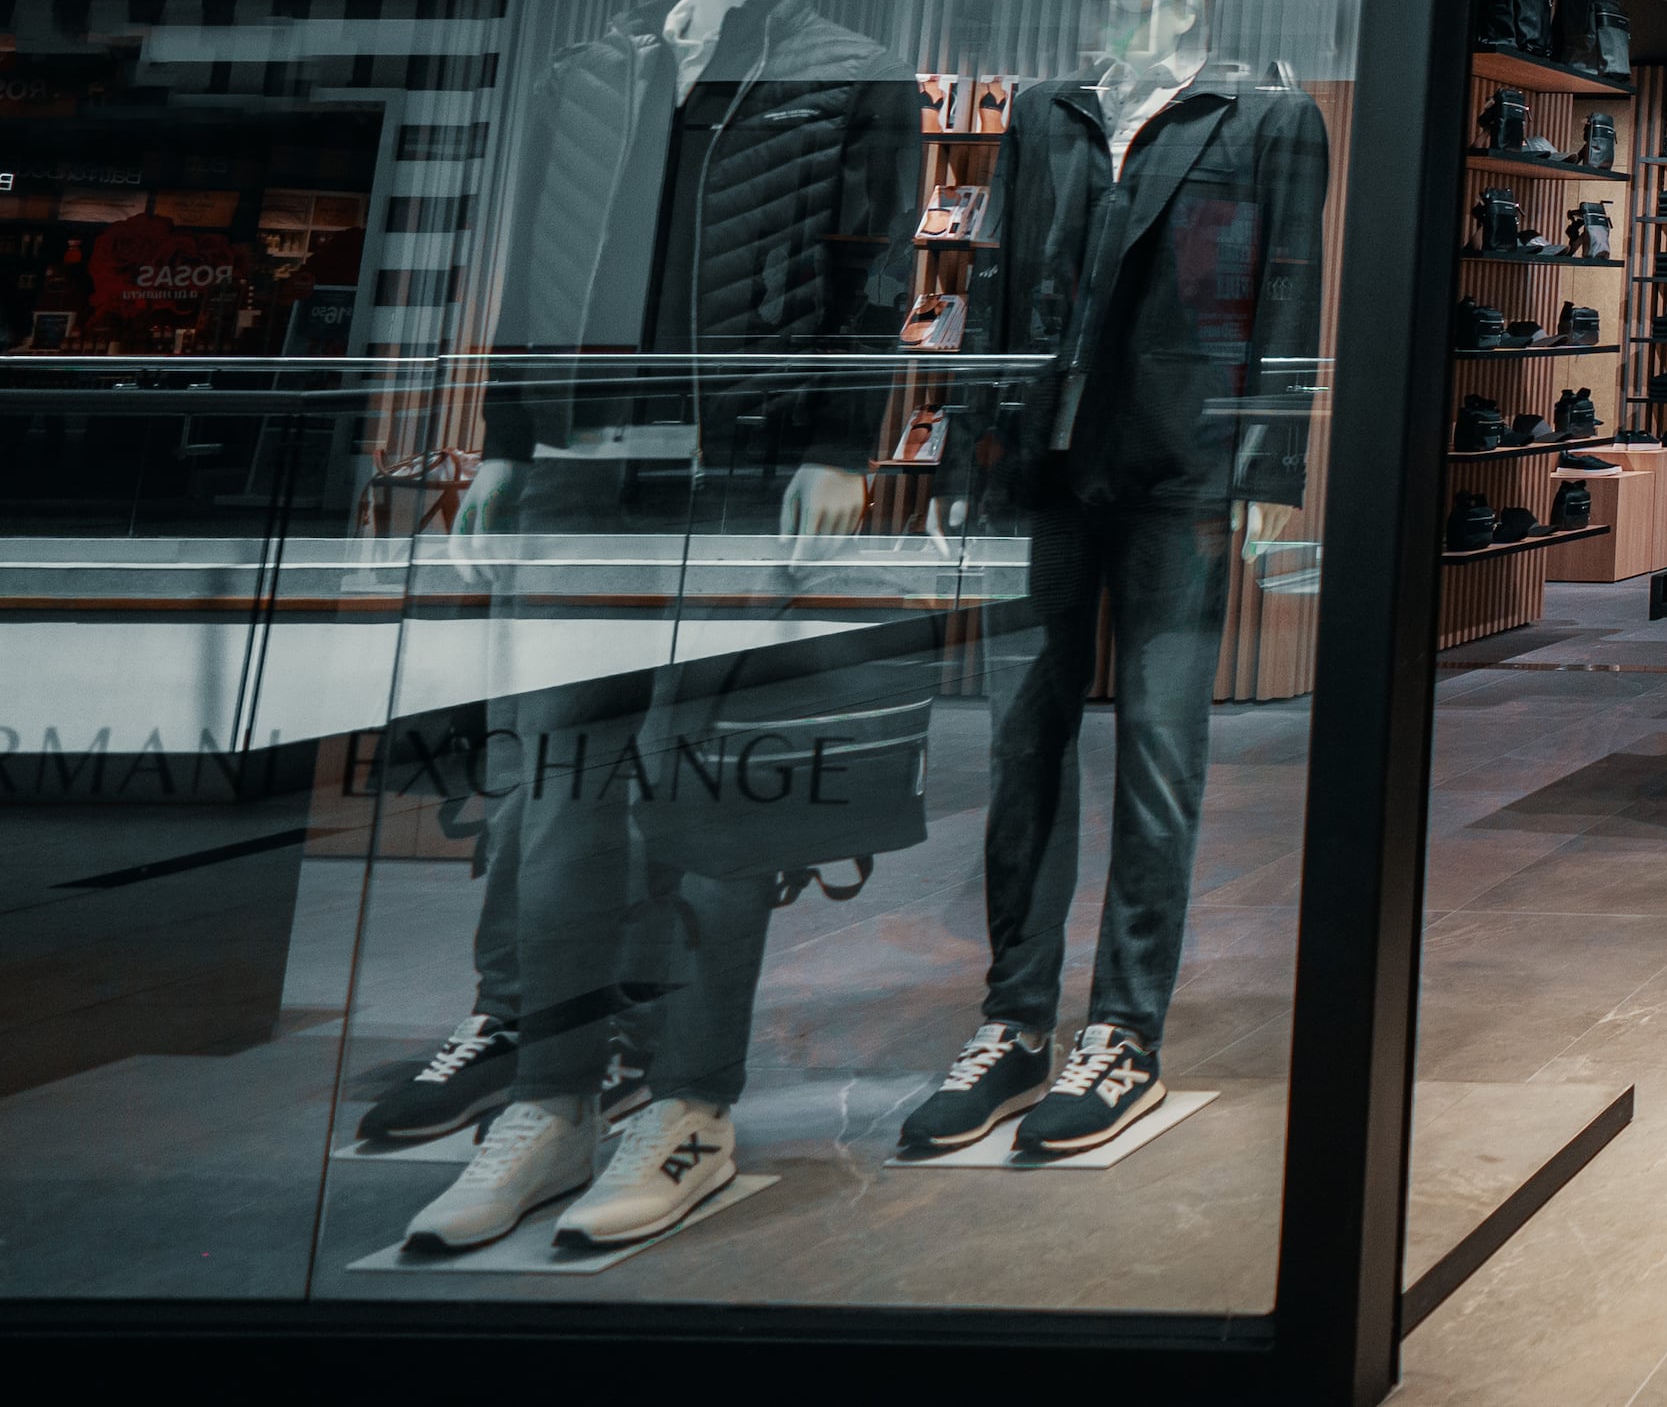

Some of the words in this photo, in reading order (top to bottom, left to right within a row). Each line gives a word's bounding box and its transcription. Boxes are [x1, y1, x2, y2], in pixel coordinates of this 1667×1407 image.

[341, 728, 853, 805] EXCHANGE
[1096, 1058, 1151, 1108] AX
[660, 1131, 722, 1186] AX
